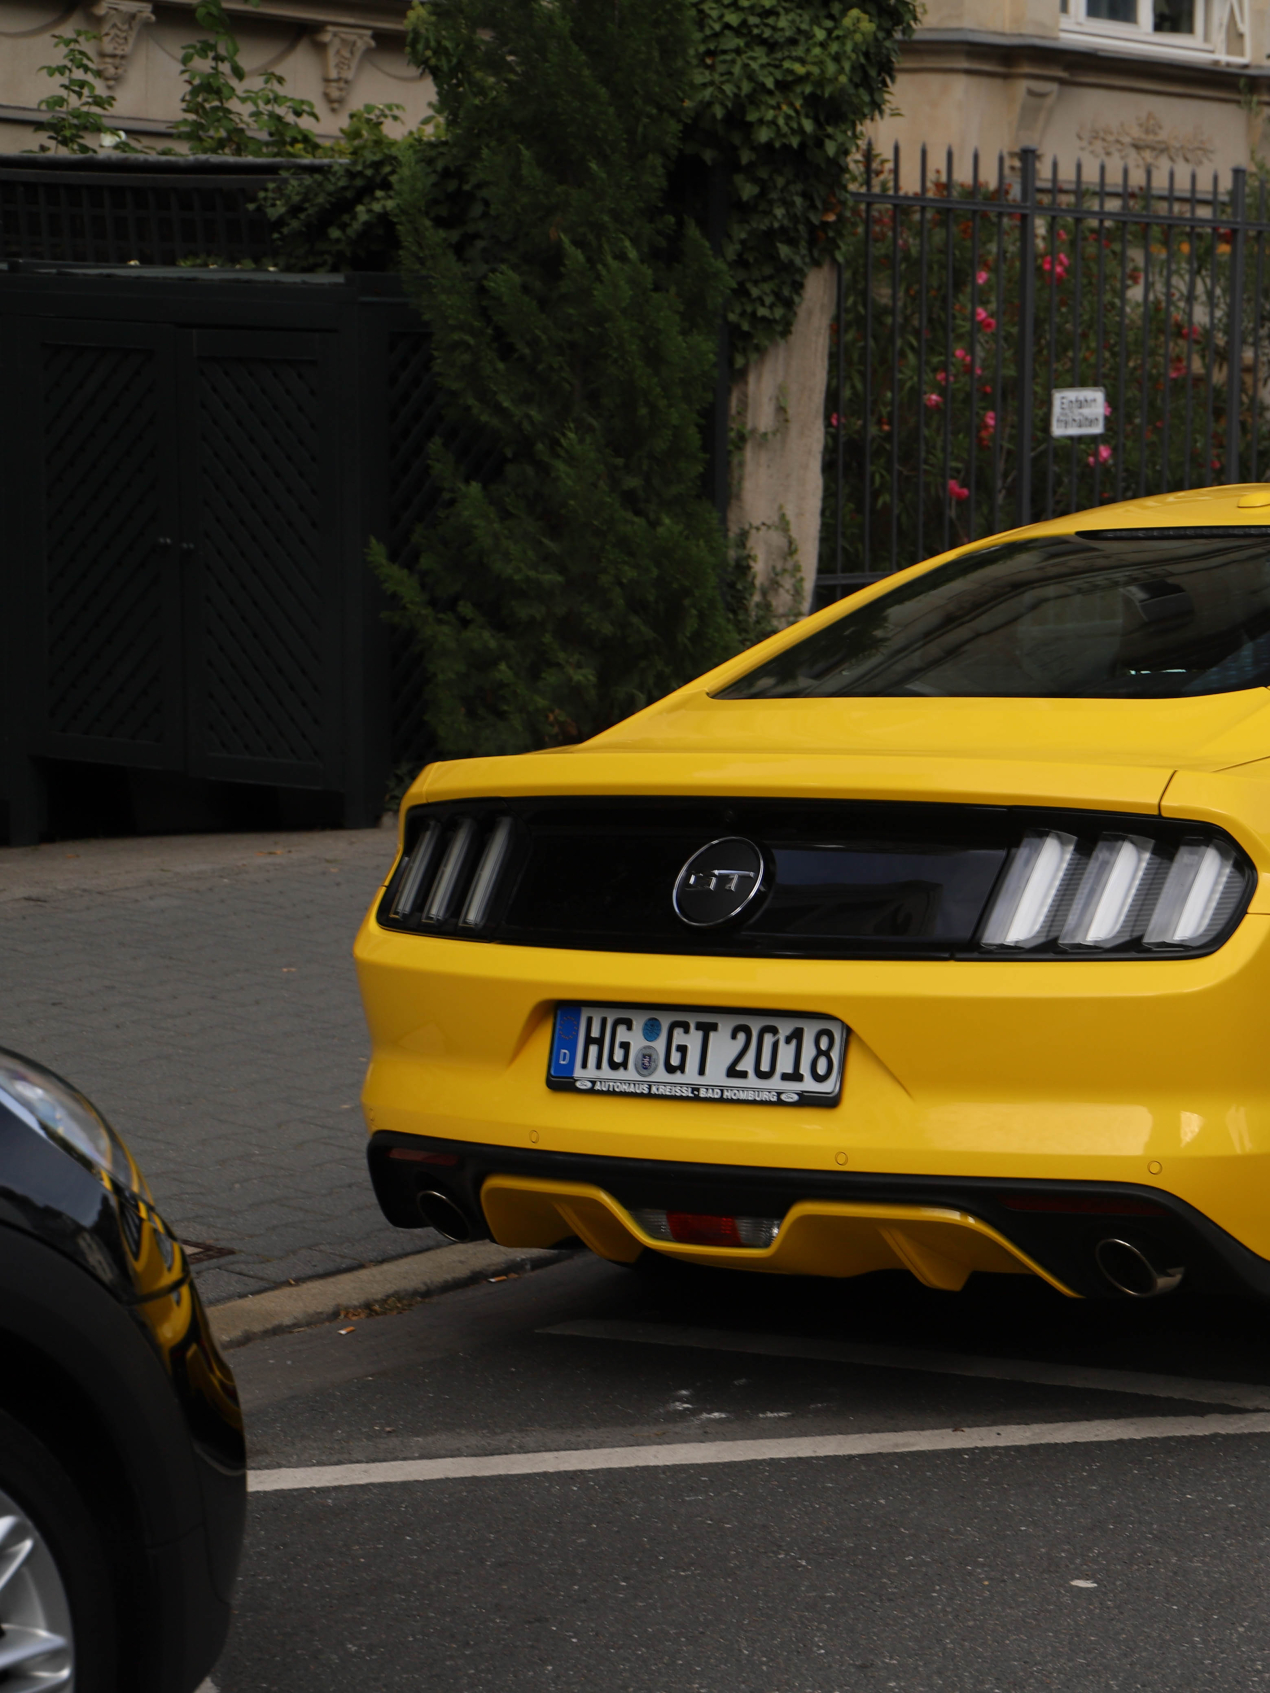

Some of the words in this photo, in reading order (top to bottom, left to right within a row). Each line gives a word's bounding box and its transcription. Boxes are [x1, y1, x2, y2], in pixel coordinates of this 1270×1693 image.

[1060, 395, 1097, 410] Einfahrt
[581, 1016, 634, 1070] HG
[664, 1020, 719, 1076] GT
[726, 1023, 836, 1083] 2018
[594, 1081, 649, 1094] AUTOHAUS
[723, 1089, 778, 1102] HOMBURG
